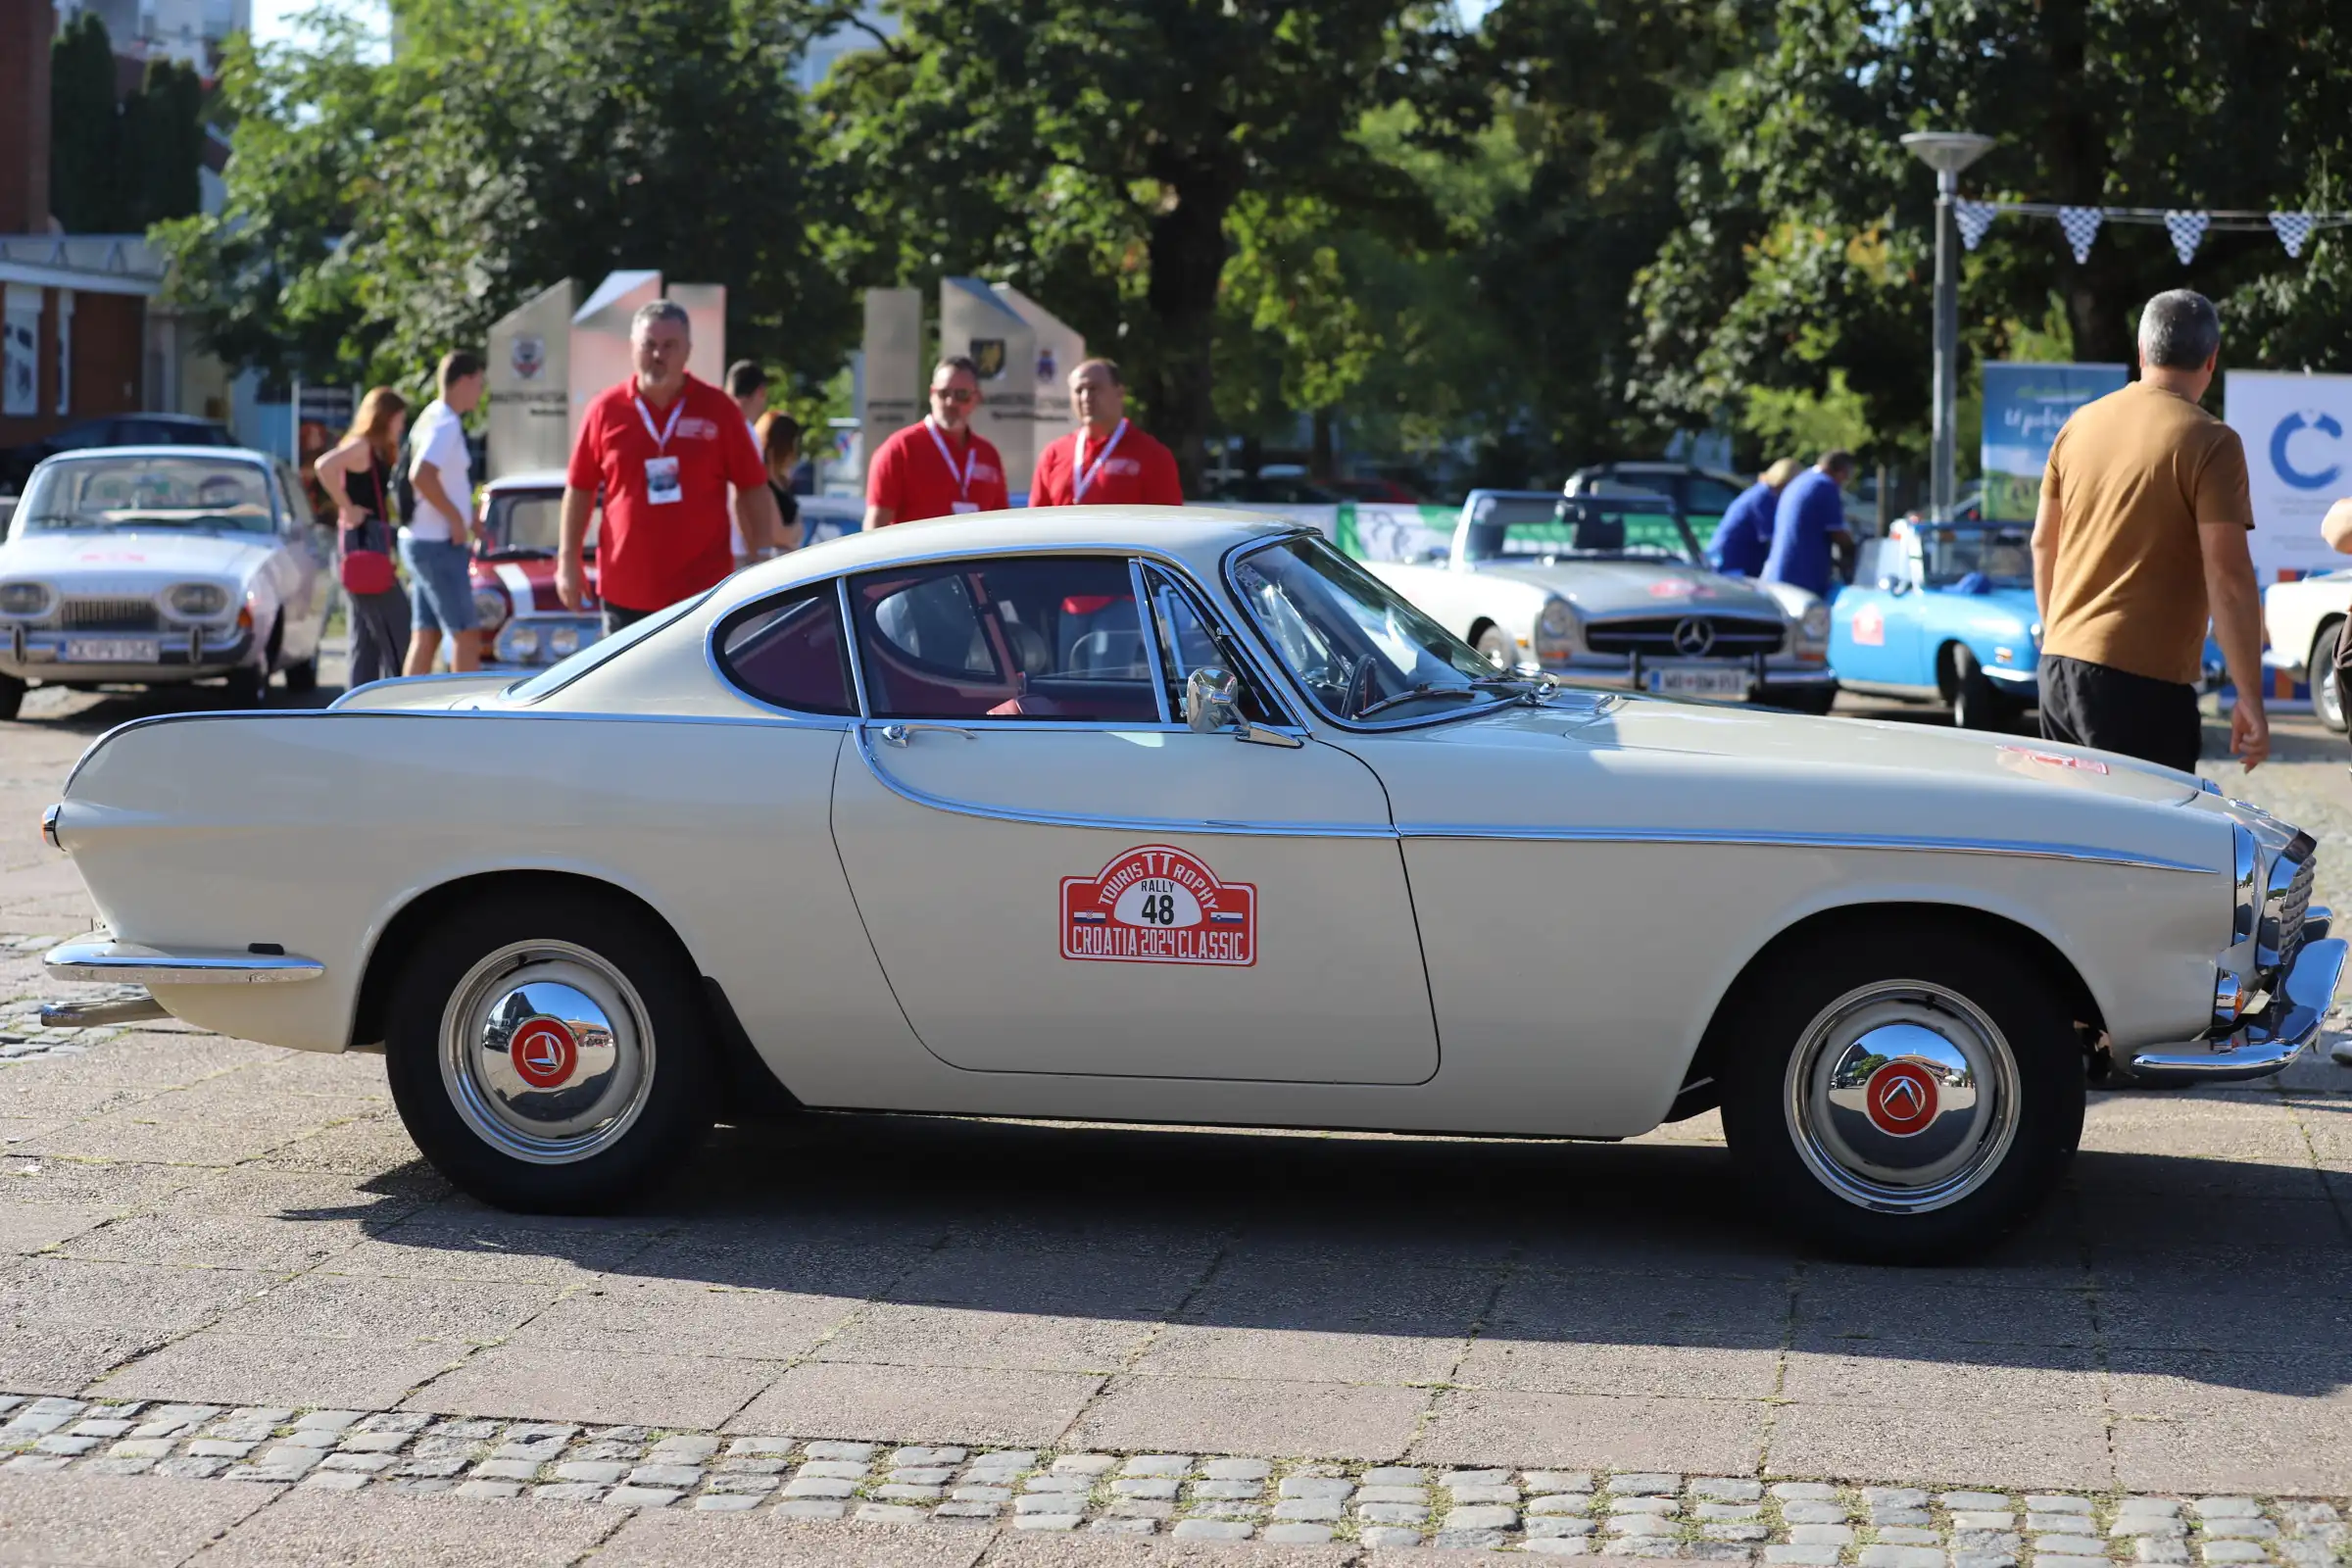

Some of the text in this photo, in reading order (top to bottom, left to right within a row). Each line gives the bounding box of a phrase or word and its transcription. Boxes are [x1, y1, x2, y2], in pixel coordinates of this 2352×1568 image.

[1141, 879, 1175, 893] RALLY
[1160, 853, 1219, 909] TROPHY
[1141, 894, 1175, 925] 48
[1072, 925, 1244, 960] CROATIA 2024 CLASSIC
